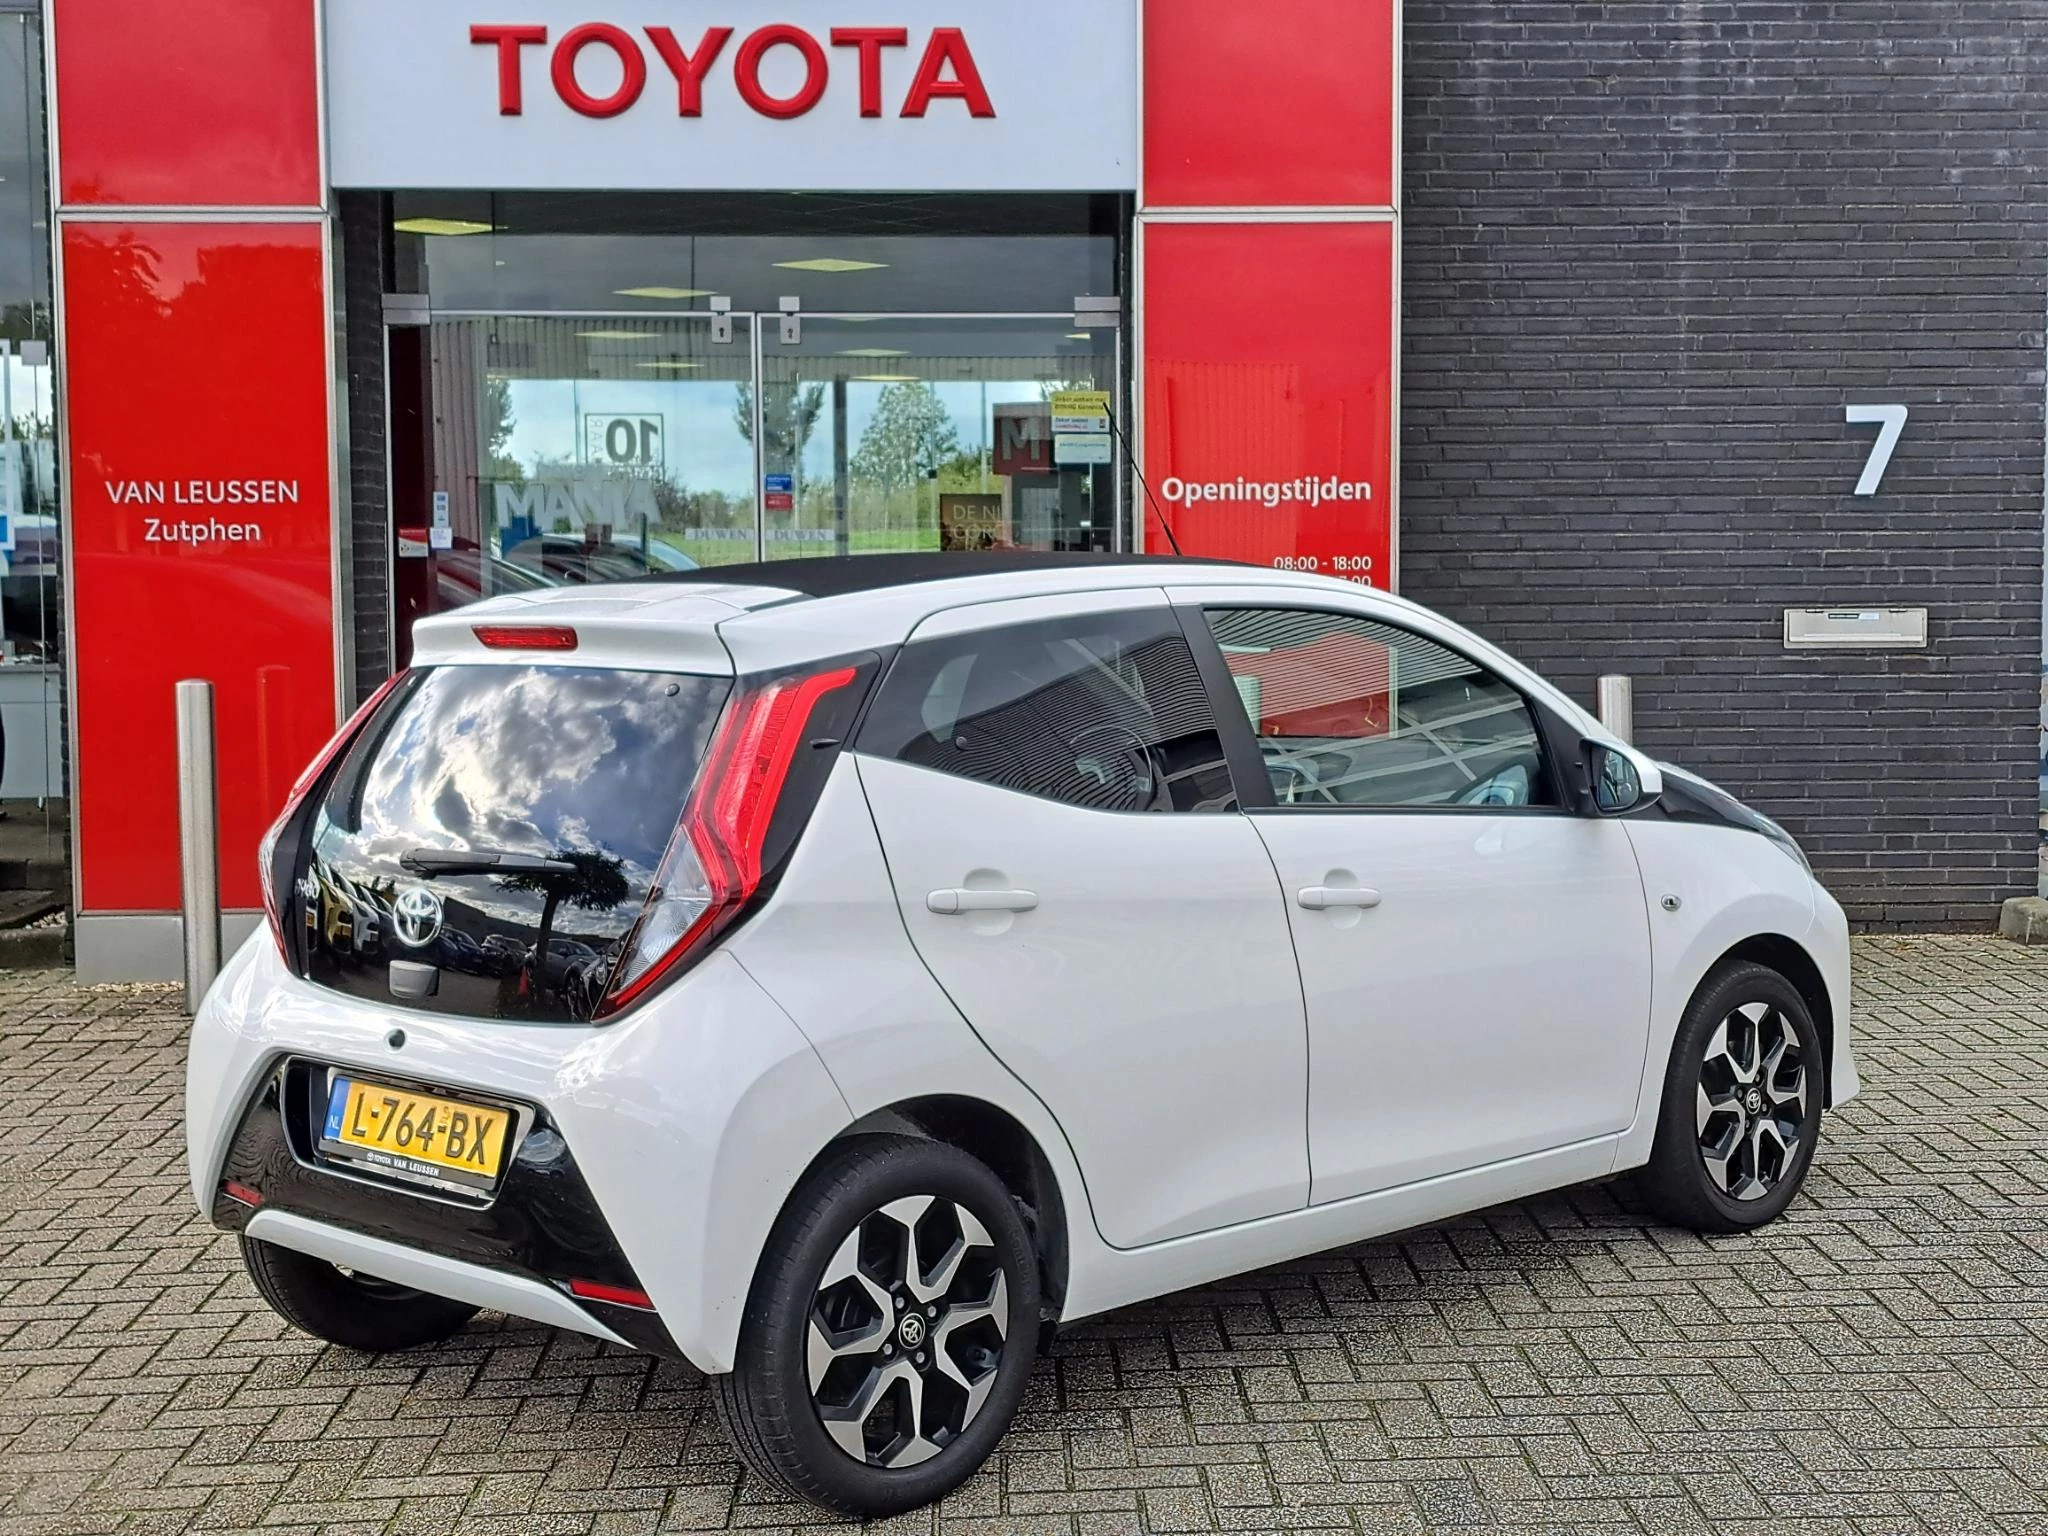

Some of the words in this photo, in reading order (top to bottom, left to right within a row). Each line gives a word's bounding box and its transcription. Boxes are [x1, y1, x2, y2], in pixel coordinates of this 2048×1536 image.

[469, 22, 997, 119] TOYOTA
[1846, 404, 1908, 495] 7
[105, 480, 165, 504] VAN
[174, 480, 299, 504] LEUSSEN
[1161, 476, 1372, 508] Openingstijden
[144, 517, 261, 547] Zutphen
[774, 528, 827, 541] DUWEN
[1273, 556, 1318, 570] 08:00
[1332, 556, 1372, 570] 18:00
[328, 1115, 340, 1130] NL
[352, 1092, 494, 1165] L-764-BX
[374, 1154, 391, 1165] TOYOTA
[393, 1158, 407, 1170] VAN
[409, 1161, 440, 1176] LEUSSEN
